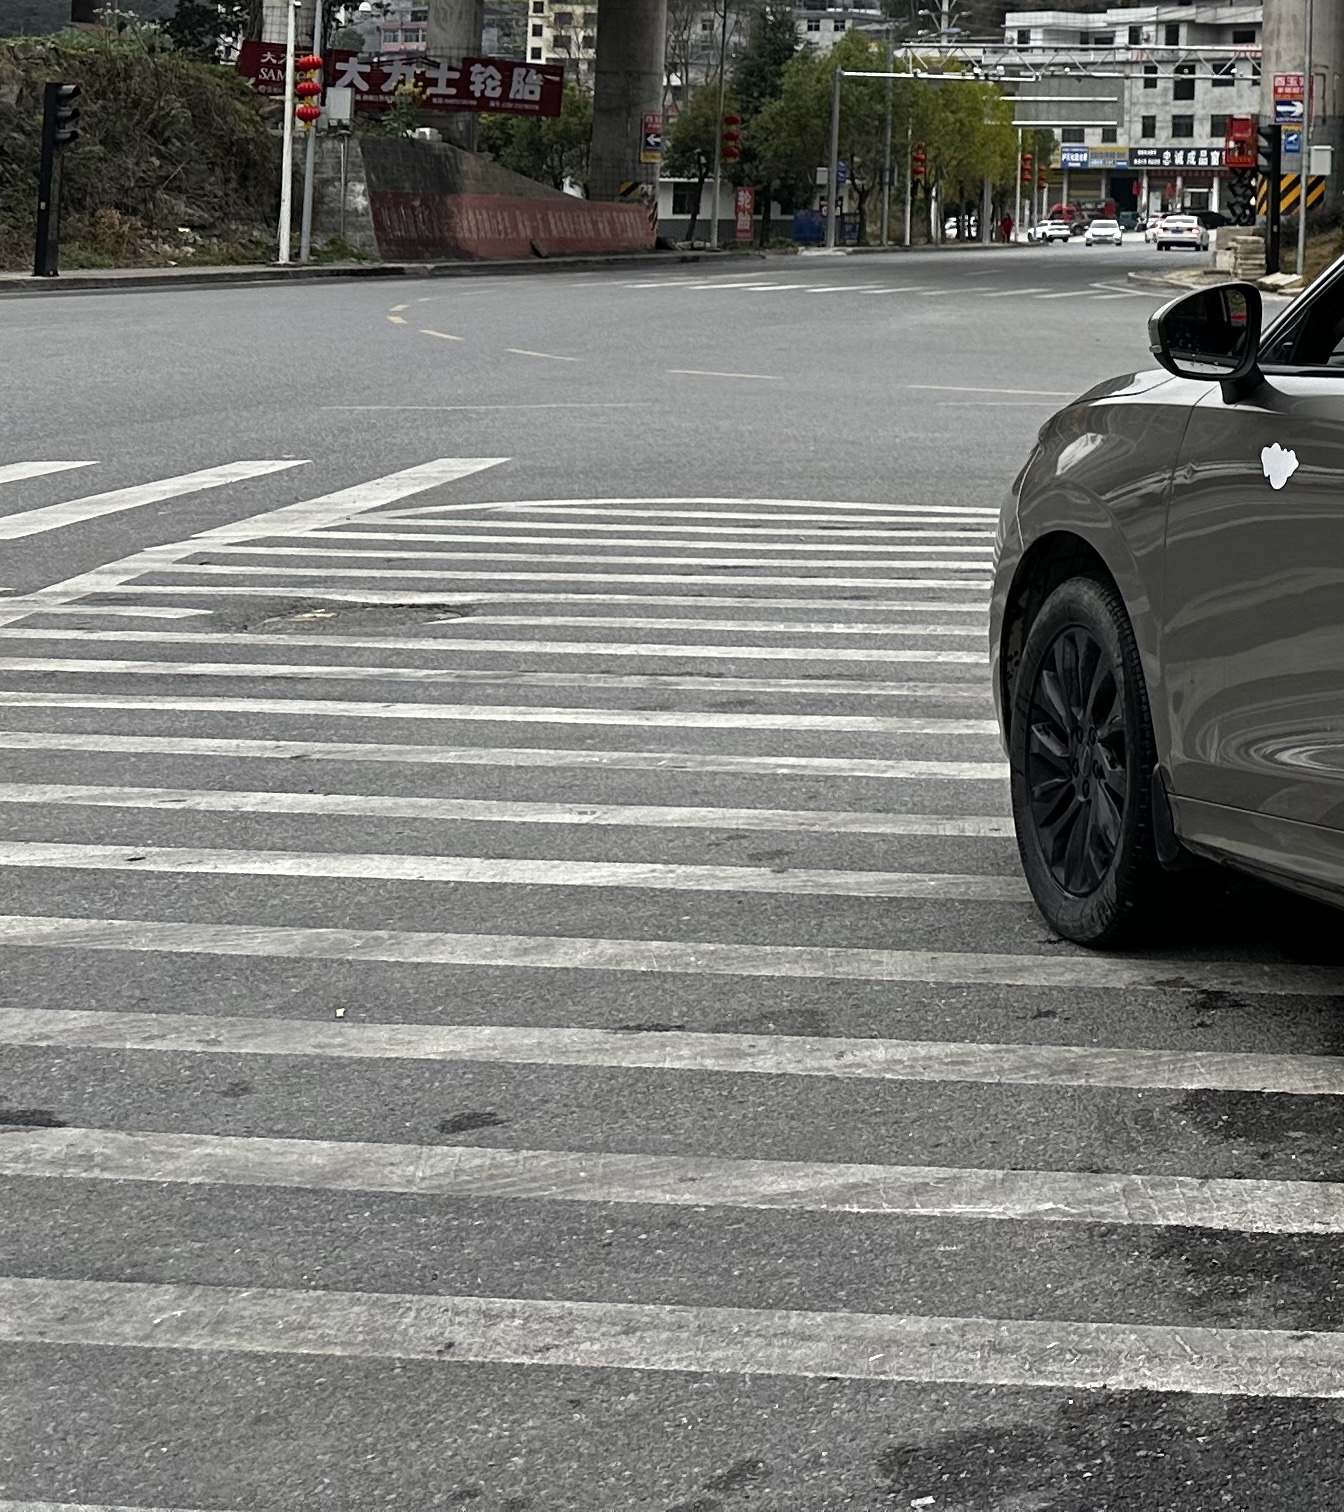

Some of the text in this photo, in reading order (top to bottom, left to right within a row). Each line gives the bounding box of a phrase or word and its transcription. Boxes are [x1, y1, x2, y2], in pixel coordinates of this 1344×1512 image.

[335, 57, 544, 101] 大力士轮胎
